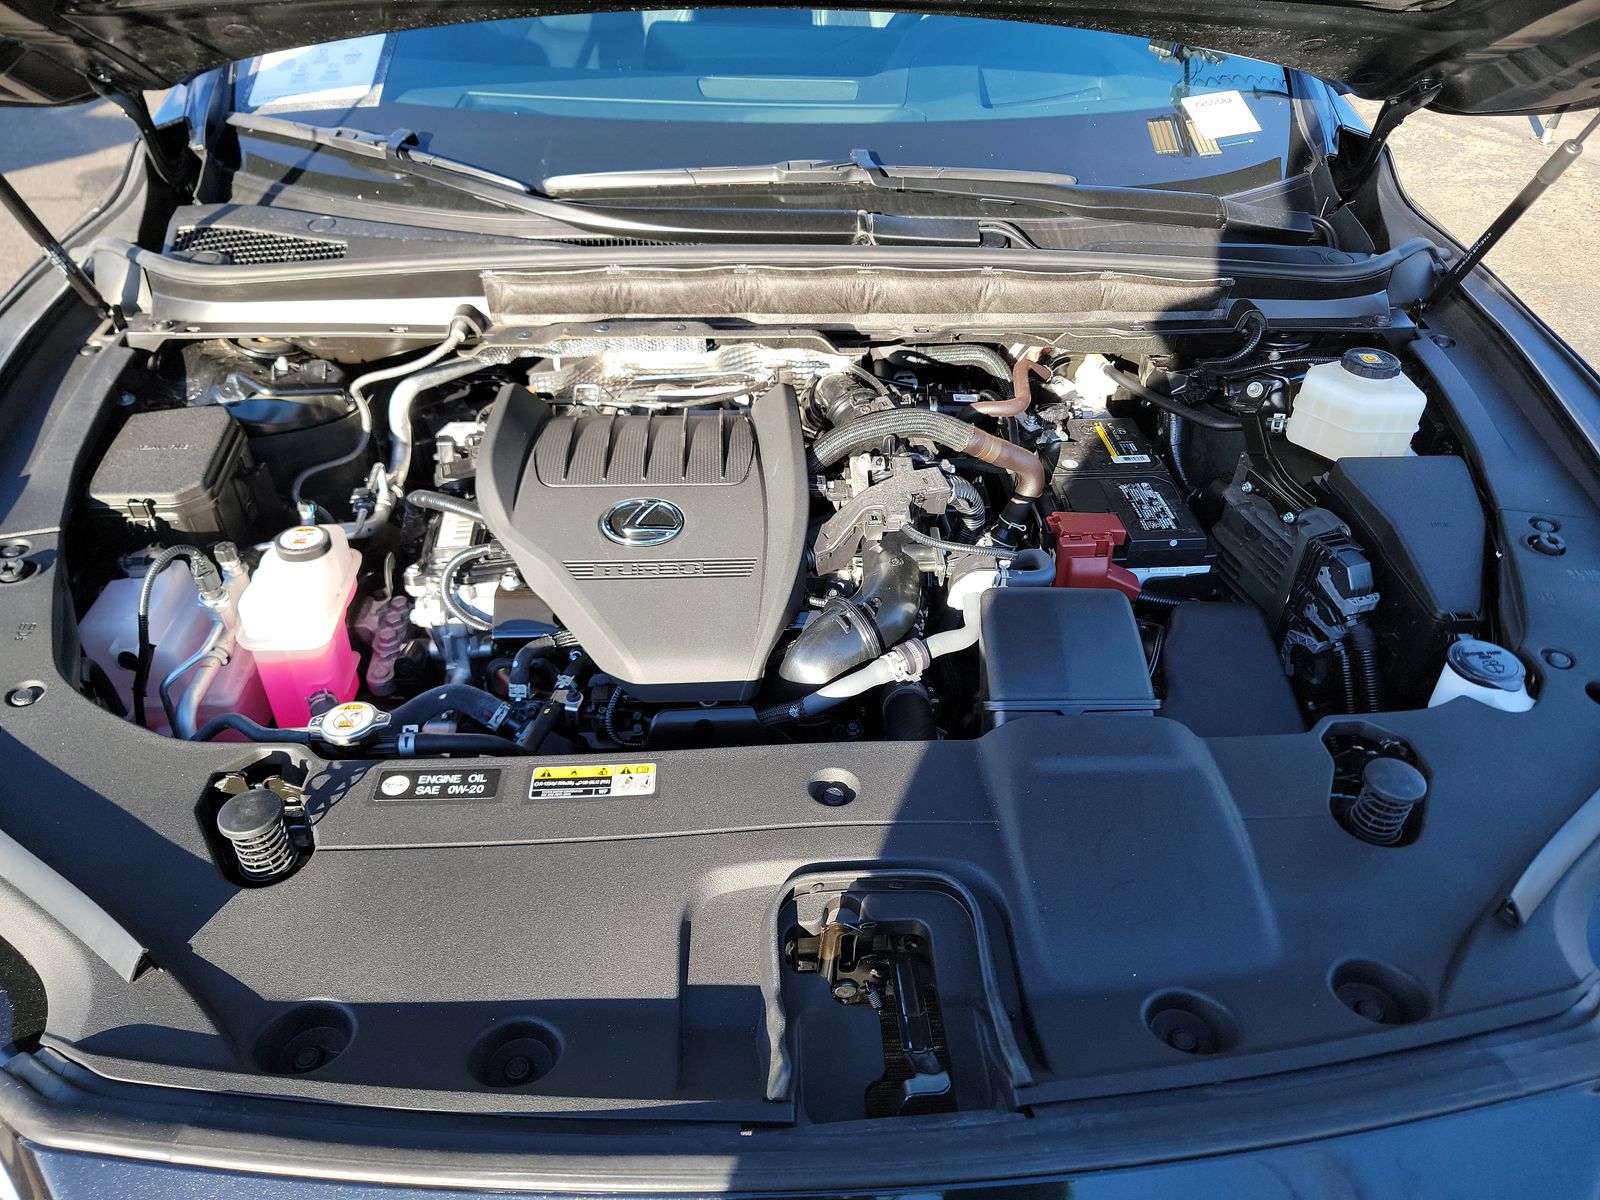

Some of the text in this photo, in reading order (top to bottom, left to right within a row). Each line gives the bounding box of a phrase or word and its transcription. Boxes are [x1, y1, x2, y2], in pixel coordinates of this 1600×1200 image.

[597, 562, 702, 576] TURBO
[418, 774, 487, 784] ENGINE OIL
[415, 785, 485, 795] SAE 0W-20
